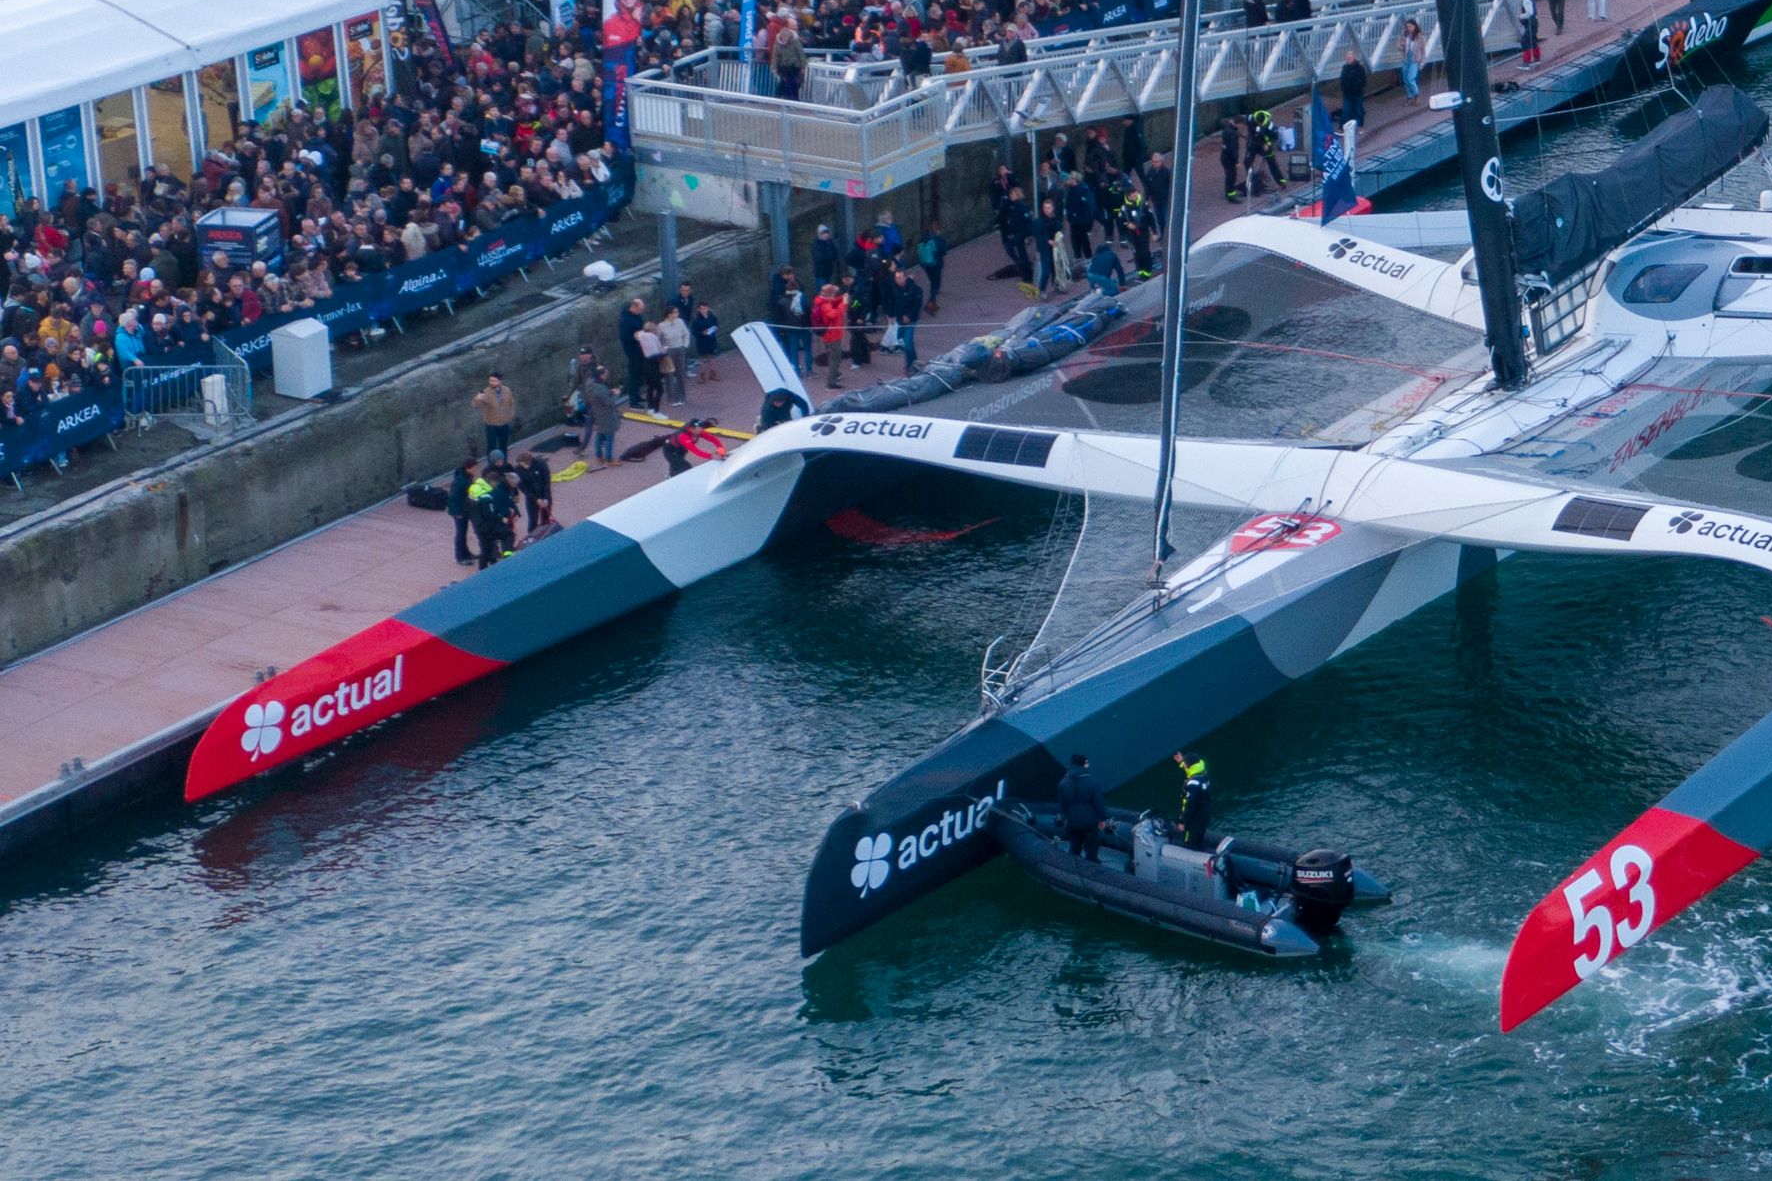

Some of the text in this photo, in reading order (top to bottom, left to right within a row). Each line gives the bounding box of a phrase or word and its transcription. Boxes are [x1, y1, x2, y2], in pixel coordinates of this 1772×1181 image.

[1103, 3, 1128, 24] ARKEA
[1655, 12, 1729, 71] Sodebo
[551, 211, 583, 235] ARKEA
[1347, 245, 1417, 281] actual
[399, 272, 438, 294] Alpina
[234, 331, 273, 357] ARKEA
[57, 403, 101, 434] ARKEA
[843, 417, 934, 440] actual
[290, 654, 406, 738] actual
[898, 779, 1005, 871] actual
[1296, 869, 1335, 881] SUZUKI
[1563, 844, 1658, 980] 53
